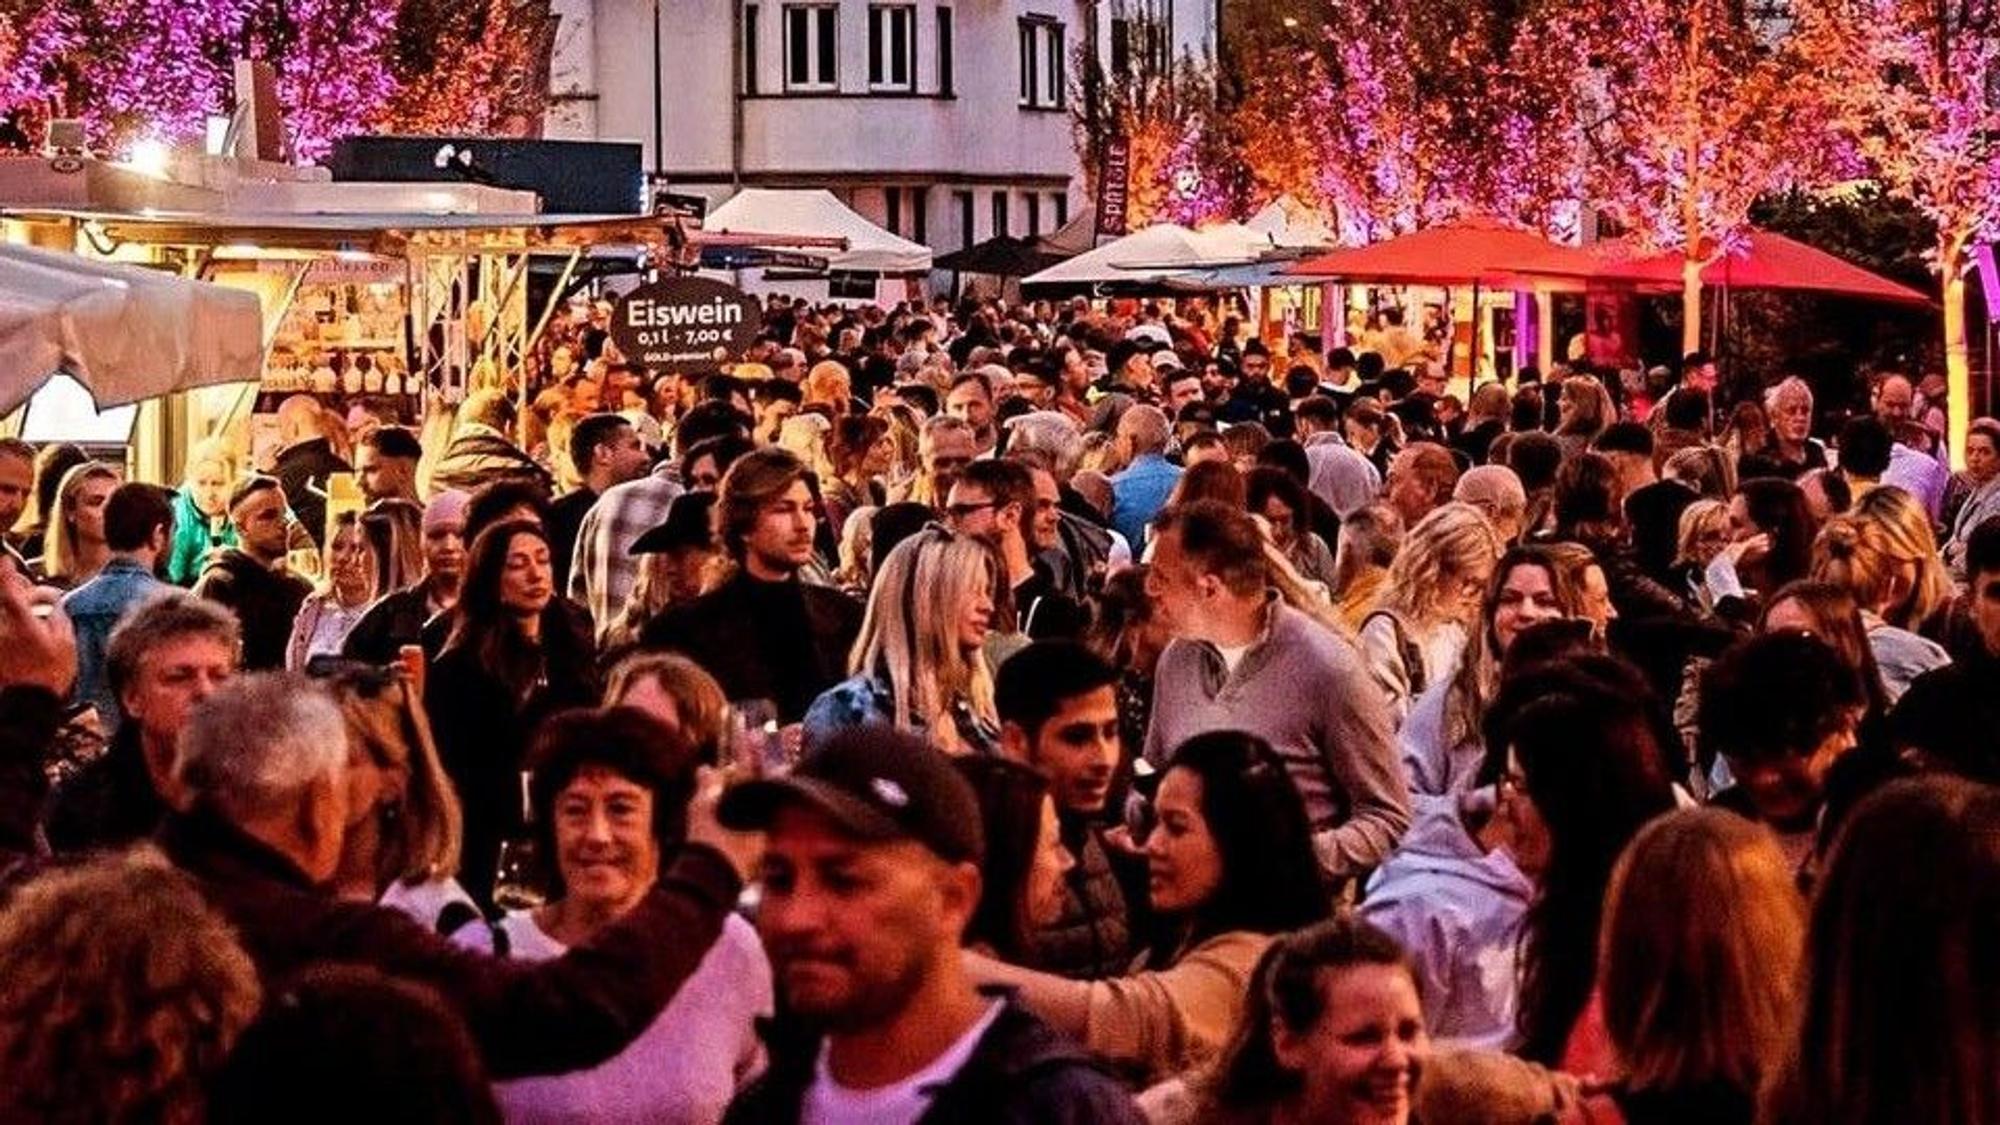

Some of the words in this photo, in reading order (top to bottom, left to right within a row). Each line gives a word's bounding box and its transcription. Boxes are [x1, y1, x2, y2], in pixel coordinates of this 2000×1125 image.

[628, 296, 742, 327] Eiswein
[637, 330, 659, 346] 0,1
[685, 329, 720, 345] 7,00
[722, 328, 733, 341] €
